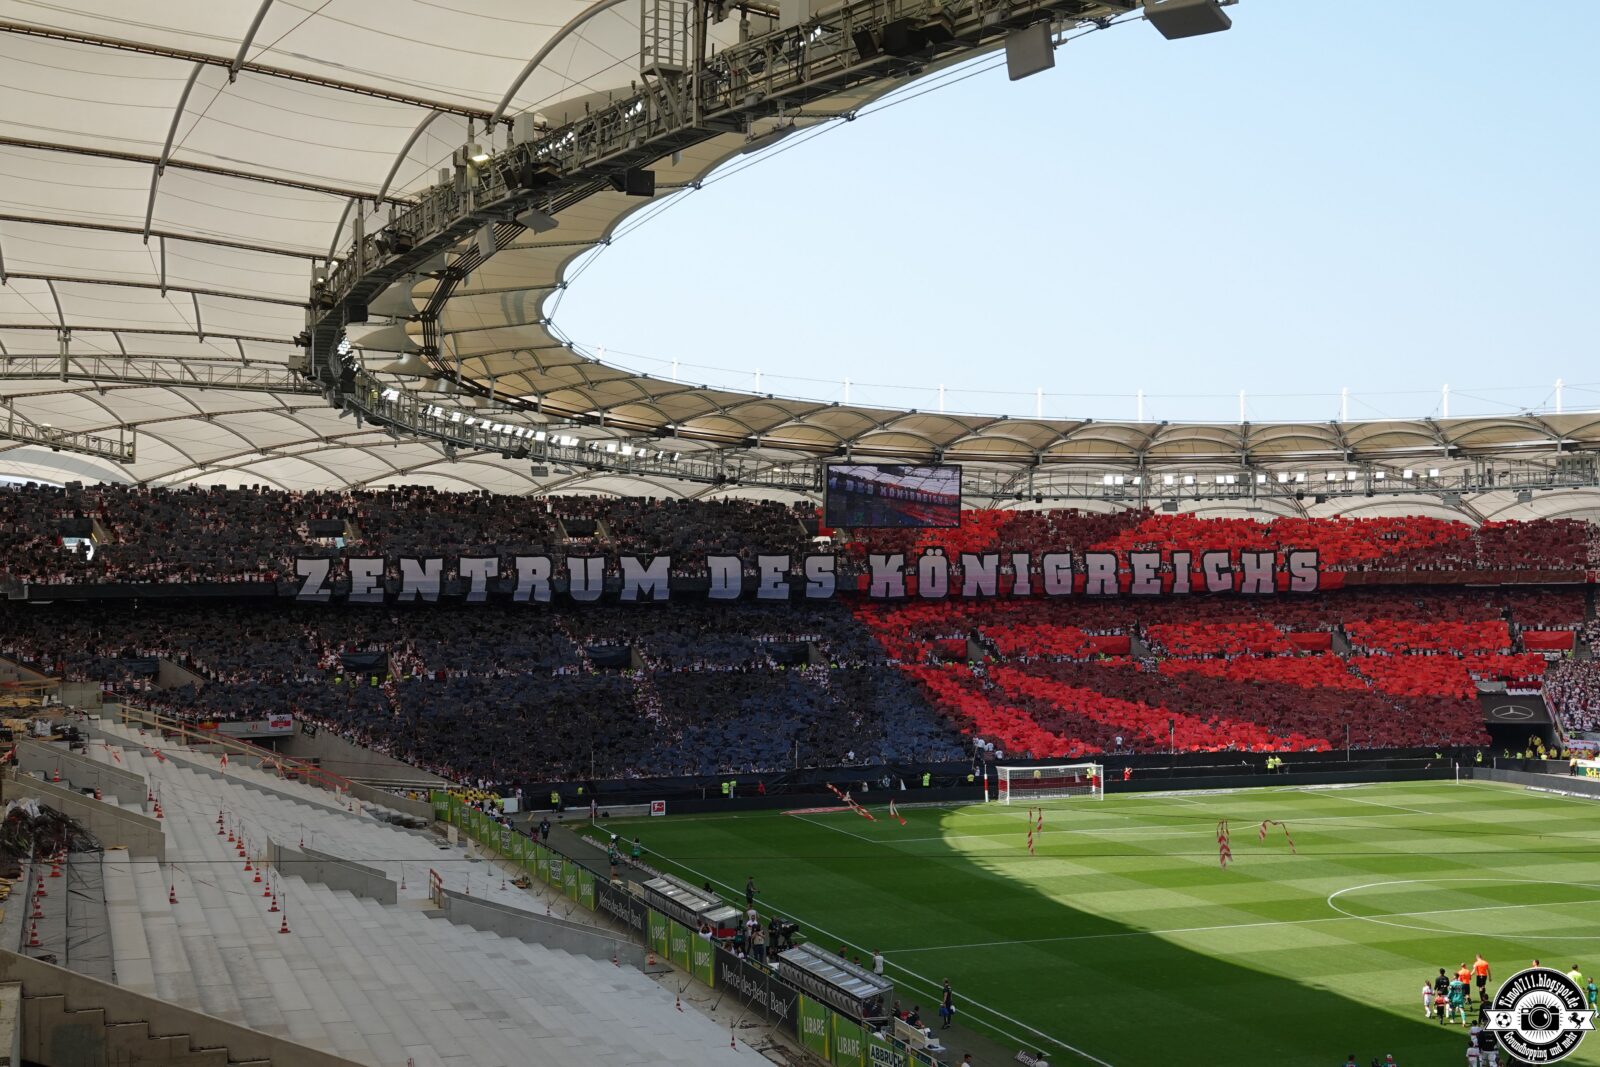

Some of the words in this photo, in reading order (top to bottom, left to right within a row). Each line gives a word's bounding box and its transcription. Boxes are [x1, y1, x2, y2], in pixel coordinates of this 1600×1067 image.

[296, 556, 671, 602] ZENTRUM
[707, 555, 836, 600] DES
[869, 548, 1318, 598] KÖNIGREICHS
[722, 962, 768, 1007] Mercedes-Benz
[770, 991, 788, 1019] Bank
[803, 1015, 825, 1037] LIBARE
[837, 1036, 861, 1058] LIBARE
[871, 1045, 903, 1067] ABBRUCH
